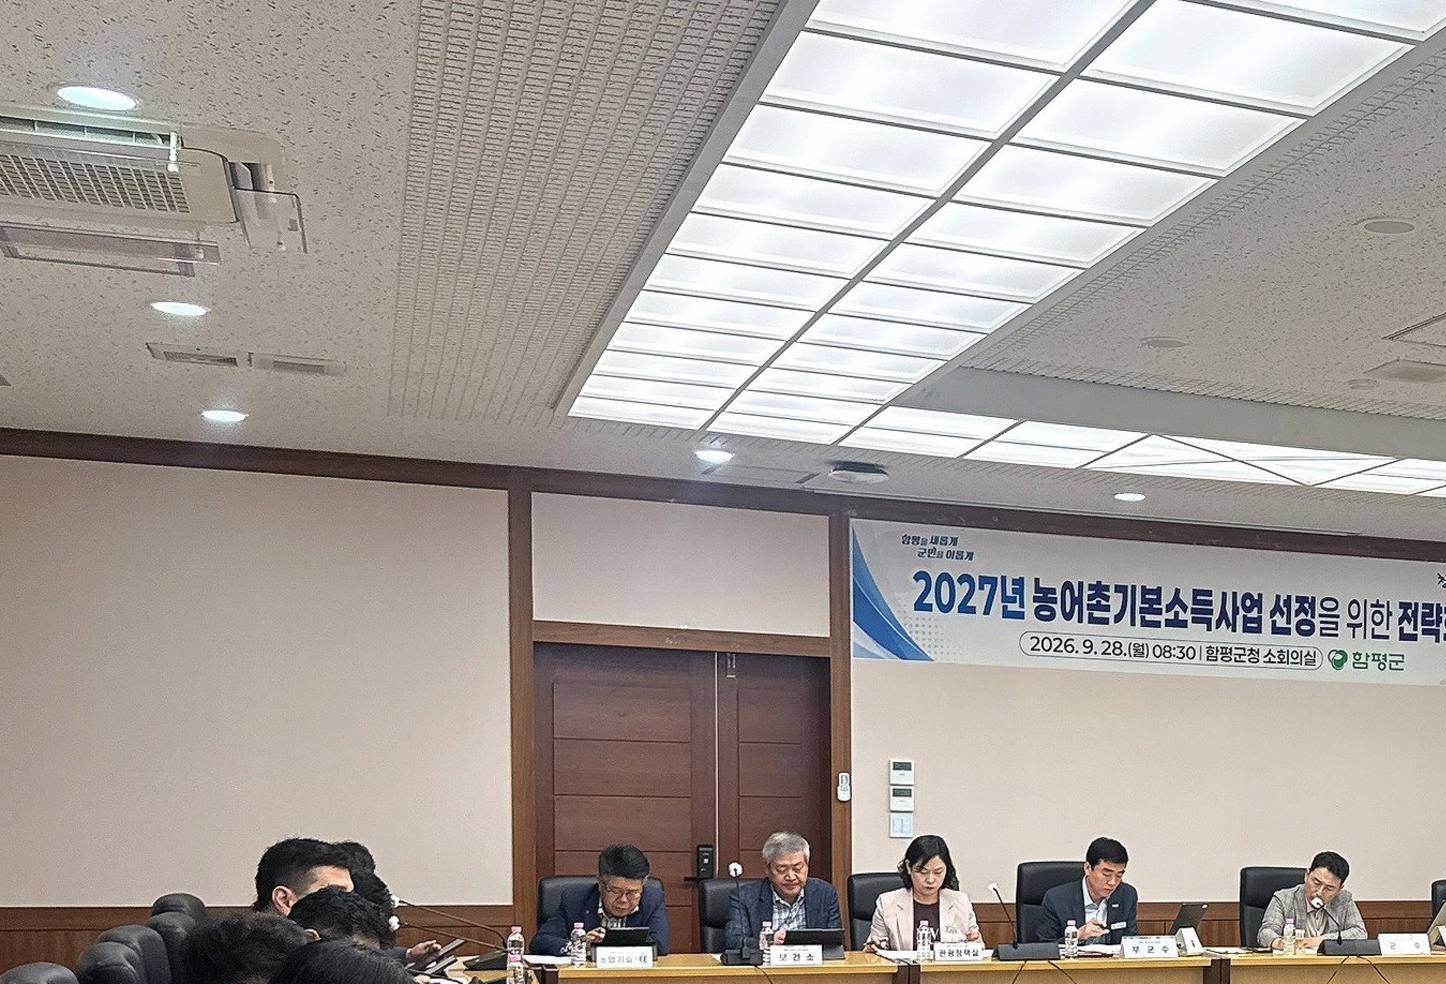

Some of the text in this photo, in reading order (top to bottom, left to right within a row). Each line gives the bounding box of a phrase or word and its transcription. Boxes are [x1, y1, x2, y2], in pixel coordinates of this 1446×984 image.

[929, 534, 959, 547] 새롭게
[917, 546, 974, 561] 군민을 이롭게
[912, 569, 1025, 621] 2027년
[1032, 576, 1263, 634] 농어촌기본소득사업
[1269, 593, 1340, 638] 선정을
[1346, 598, 1393, 640] 위한
[1029, 635, 1317, 668] 2026. 9. 28.(월) 08:30 함평군청 소회의실
[1351, 650, 1405, 671] 함평군
[1132, 945, 1169, 954] 부군수
